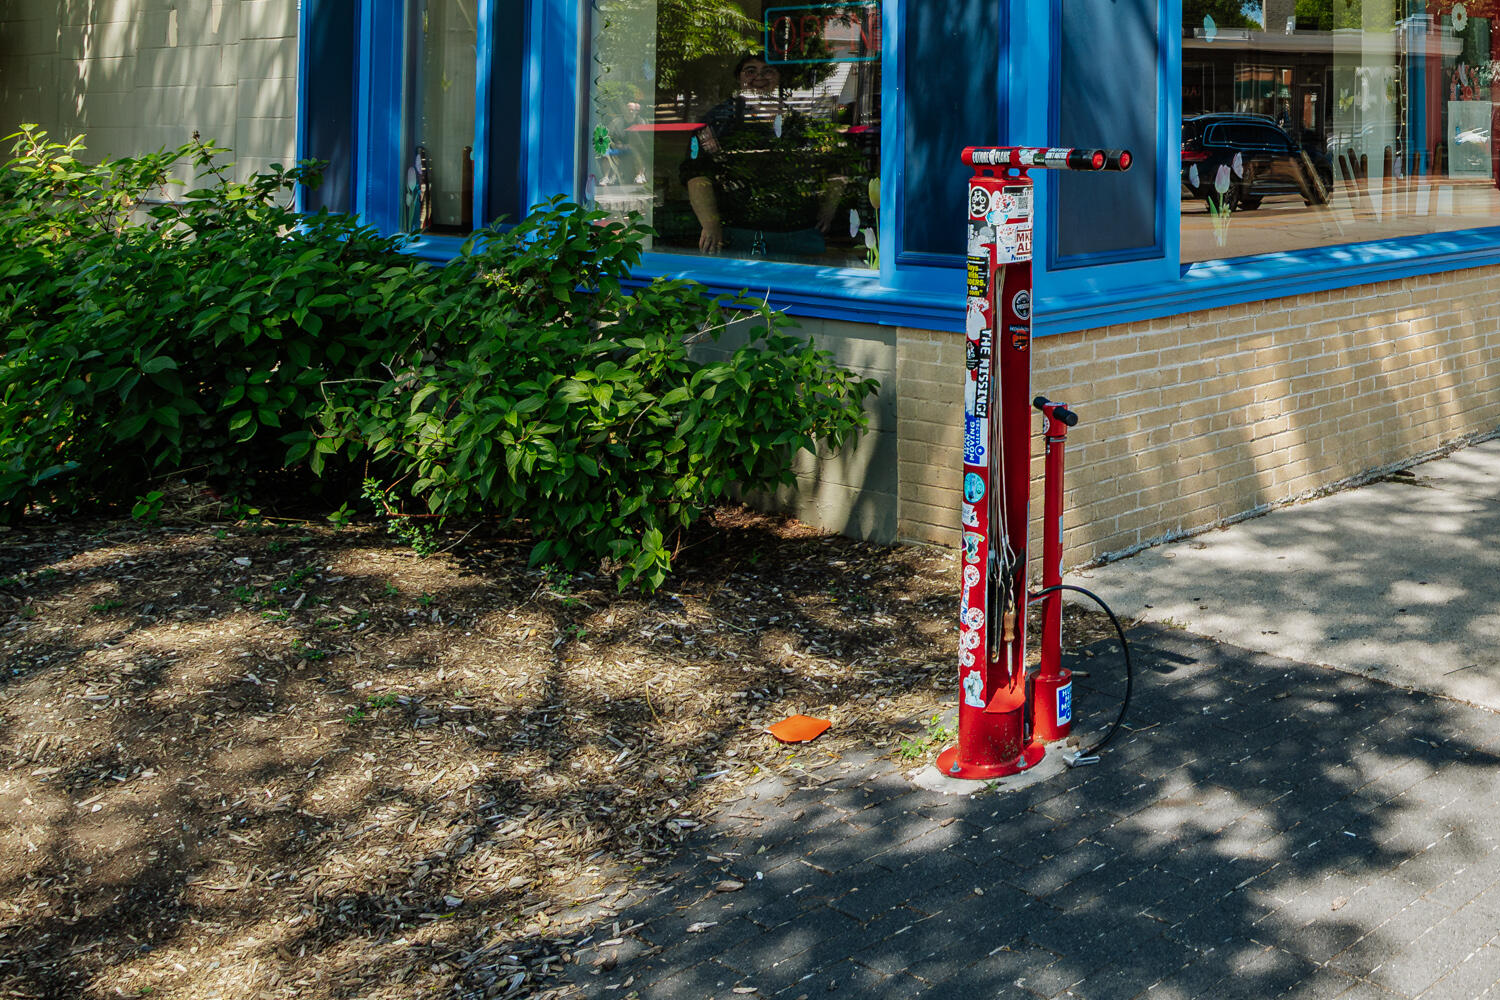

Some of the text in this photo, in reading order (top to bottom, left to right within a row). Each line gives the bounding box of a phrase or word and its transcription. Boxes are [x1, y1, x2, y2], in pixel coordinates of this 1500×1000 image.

[770, 9, 883, 56] OPEN
[975, 329, 992, 418] THE MISSING!
